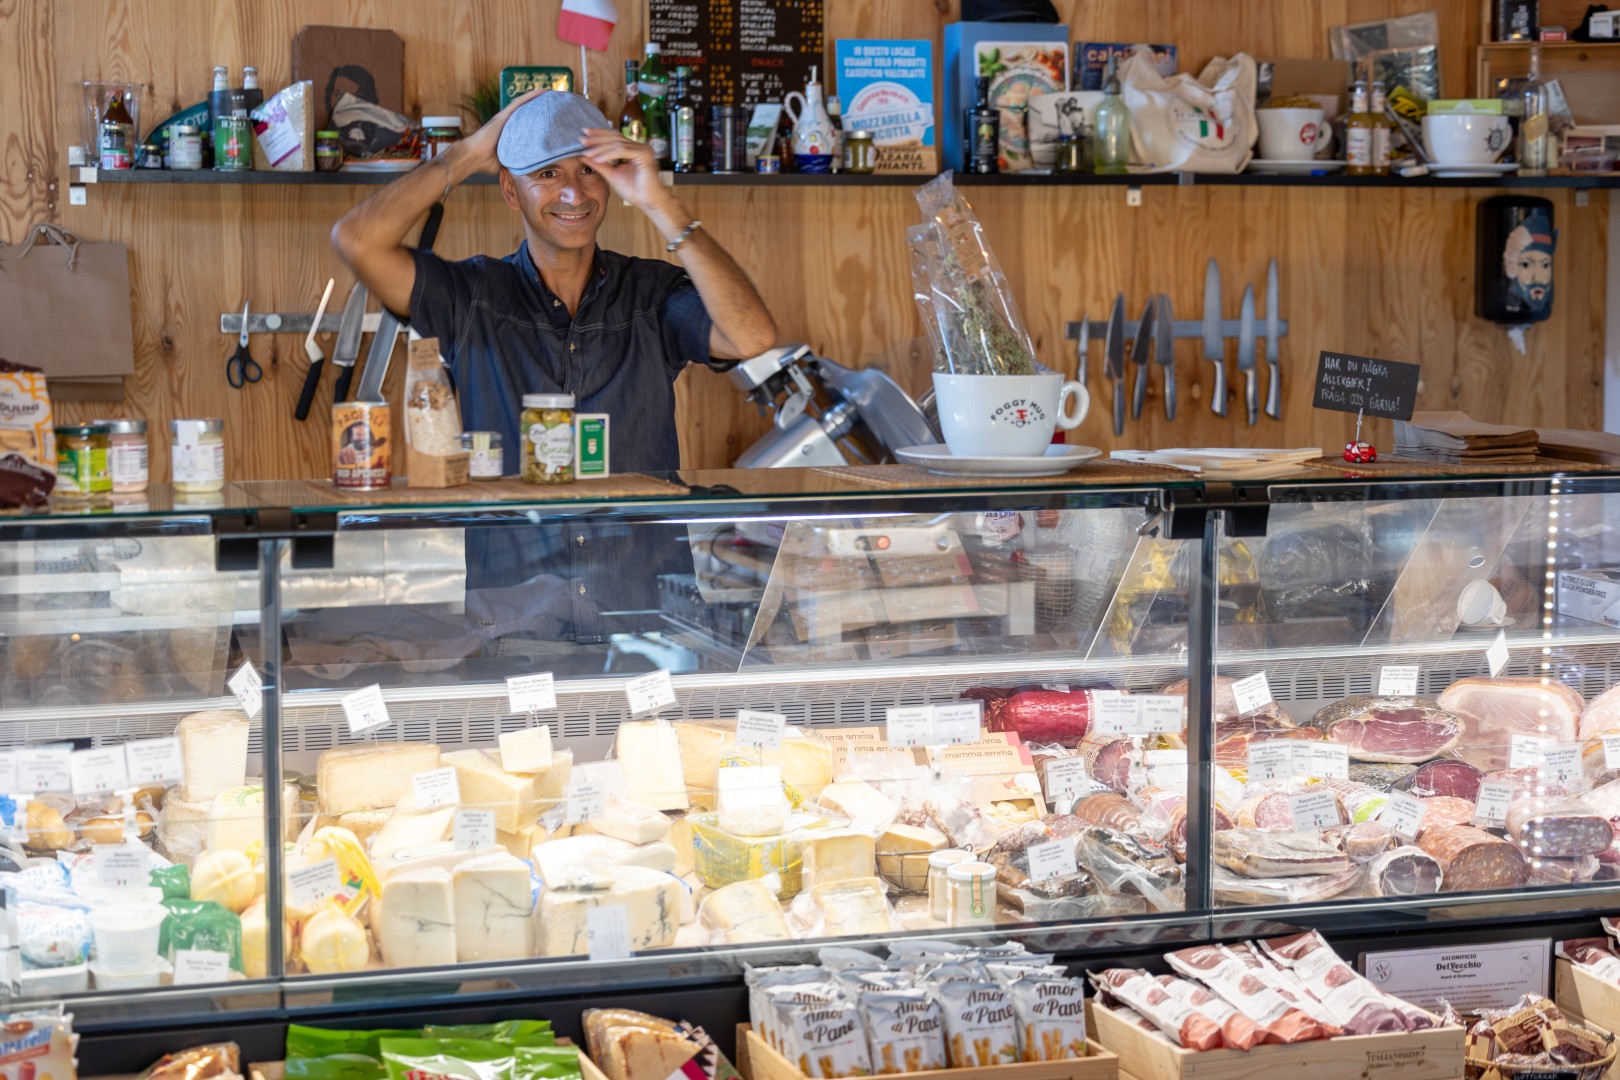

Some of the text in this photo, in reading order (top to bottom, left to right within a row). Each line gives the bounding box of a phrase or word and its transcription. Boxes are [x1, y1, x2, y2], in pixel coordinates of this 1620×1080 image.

[851, 112, 922, 130] MOZZARELLA
[1324, 356, 1389, 378] HAR DU NÅGRA
[1321, 386, 1346, 405] FRÅGA
[1350, 393, 1364, 407] OSS
[990, 399, 1046, 421] FOGGY MUG
[944, 749, 1013, 760] mamma emma
[1441, 953, 1477, 962] SALUMIFICIO
[966, 990, 1004, 1007] Amor
[1036, 982, 1079, 999] Amor
[894, 1001, 934, 1018] Amor
[961, 1003, 1013, 1024] di Pane
[1033, 998, 1083, 1017] di Pane
[803, 1009, 843, 1027] Amor
[891, 1014, 940, 1034] di Pane
[803, 1019, 855, 1043] di Pane
